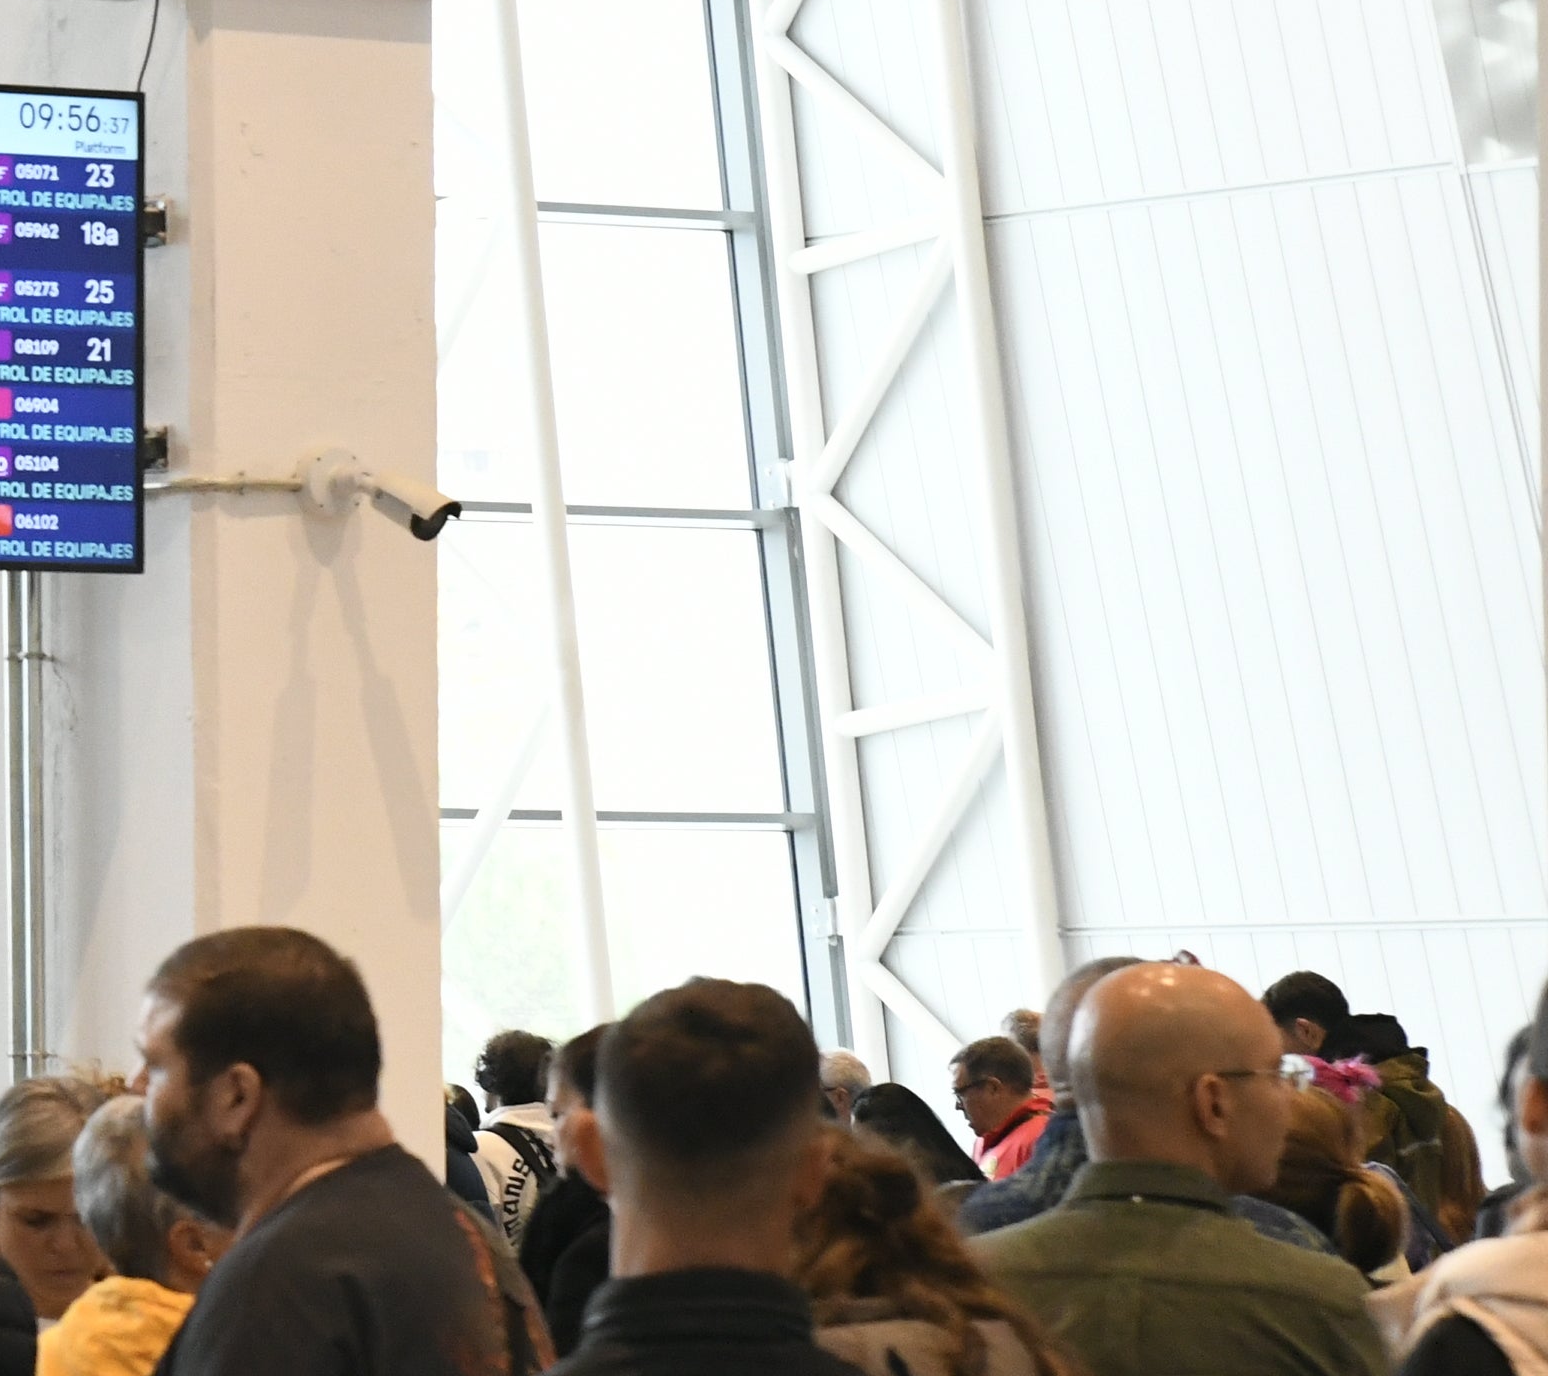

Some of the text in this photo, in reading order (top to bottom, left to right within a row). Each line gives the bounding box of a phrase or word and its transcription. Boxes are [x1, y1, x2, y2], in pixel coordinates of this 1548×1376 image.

[14, 163, 60, 181] 05071
[85, 163, 116, 188] 23
[32, 191, 53, 208] DE
[54, 192, 135, 211] EQUIPAJES
[14, 221, 60, 240] 05962
[80, 221, 120, 246] 18a
[14, 280, 60, 297] 05273
[84, 279, 115, 304] 25
[32, 308, 53, 324] DE
[54, 309, 135, 327] EQUIPAJES
[14, 338, 59, 355] 08109
[86, 337, 112, 362] 21
[32, 366, 53, 383] DE
[54, 367, 135, 386] EQUIPAJES
[14, 396, 59, 414] 06904
[32, 425, 53, 441] DE
[54, 425, 135, 444] EQUIPAJES
[14, 455, 59, 472] 05104
[32, 482, 53, 499] DE
[54, 483, 135, 502] EQUIPAJES
[14, 513, 59, 530] 06102
[32, 541, 53, 557] DE
[54, 541, 135, 559] EQUIPAJES
